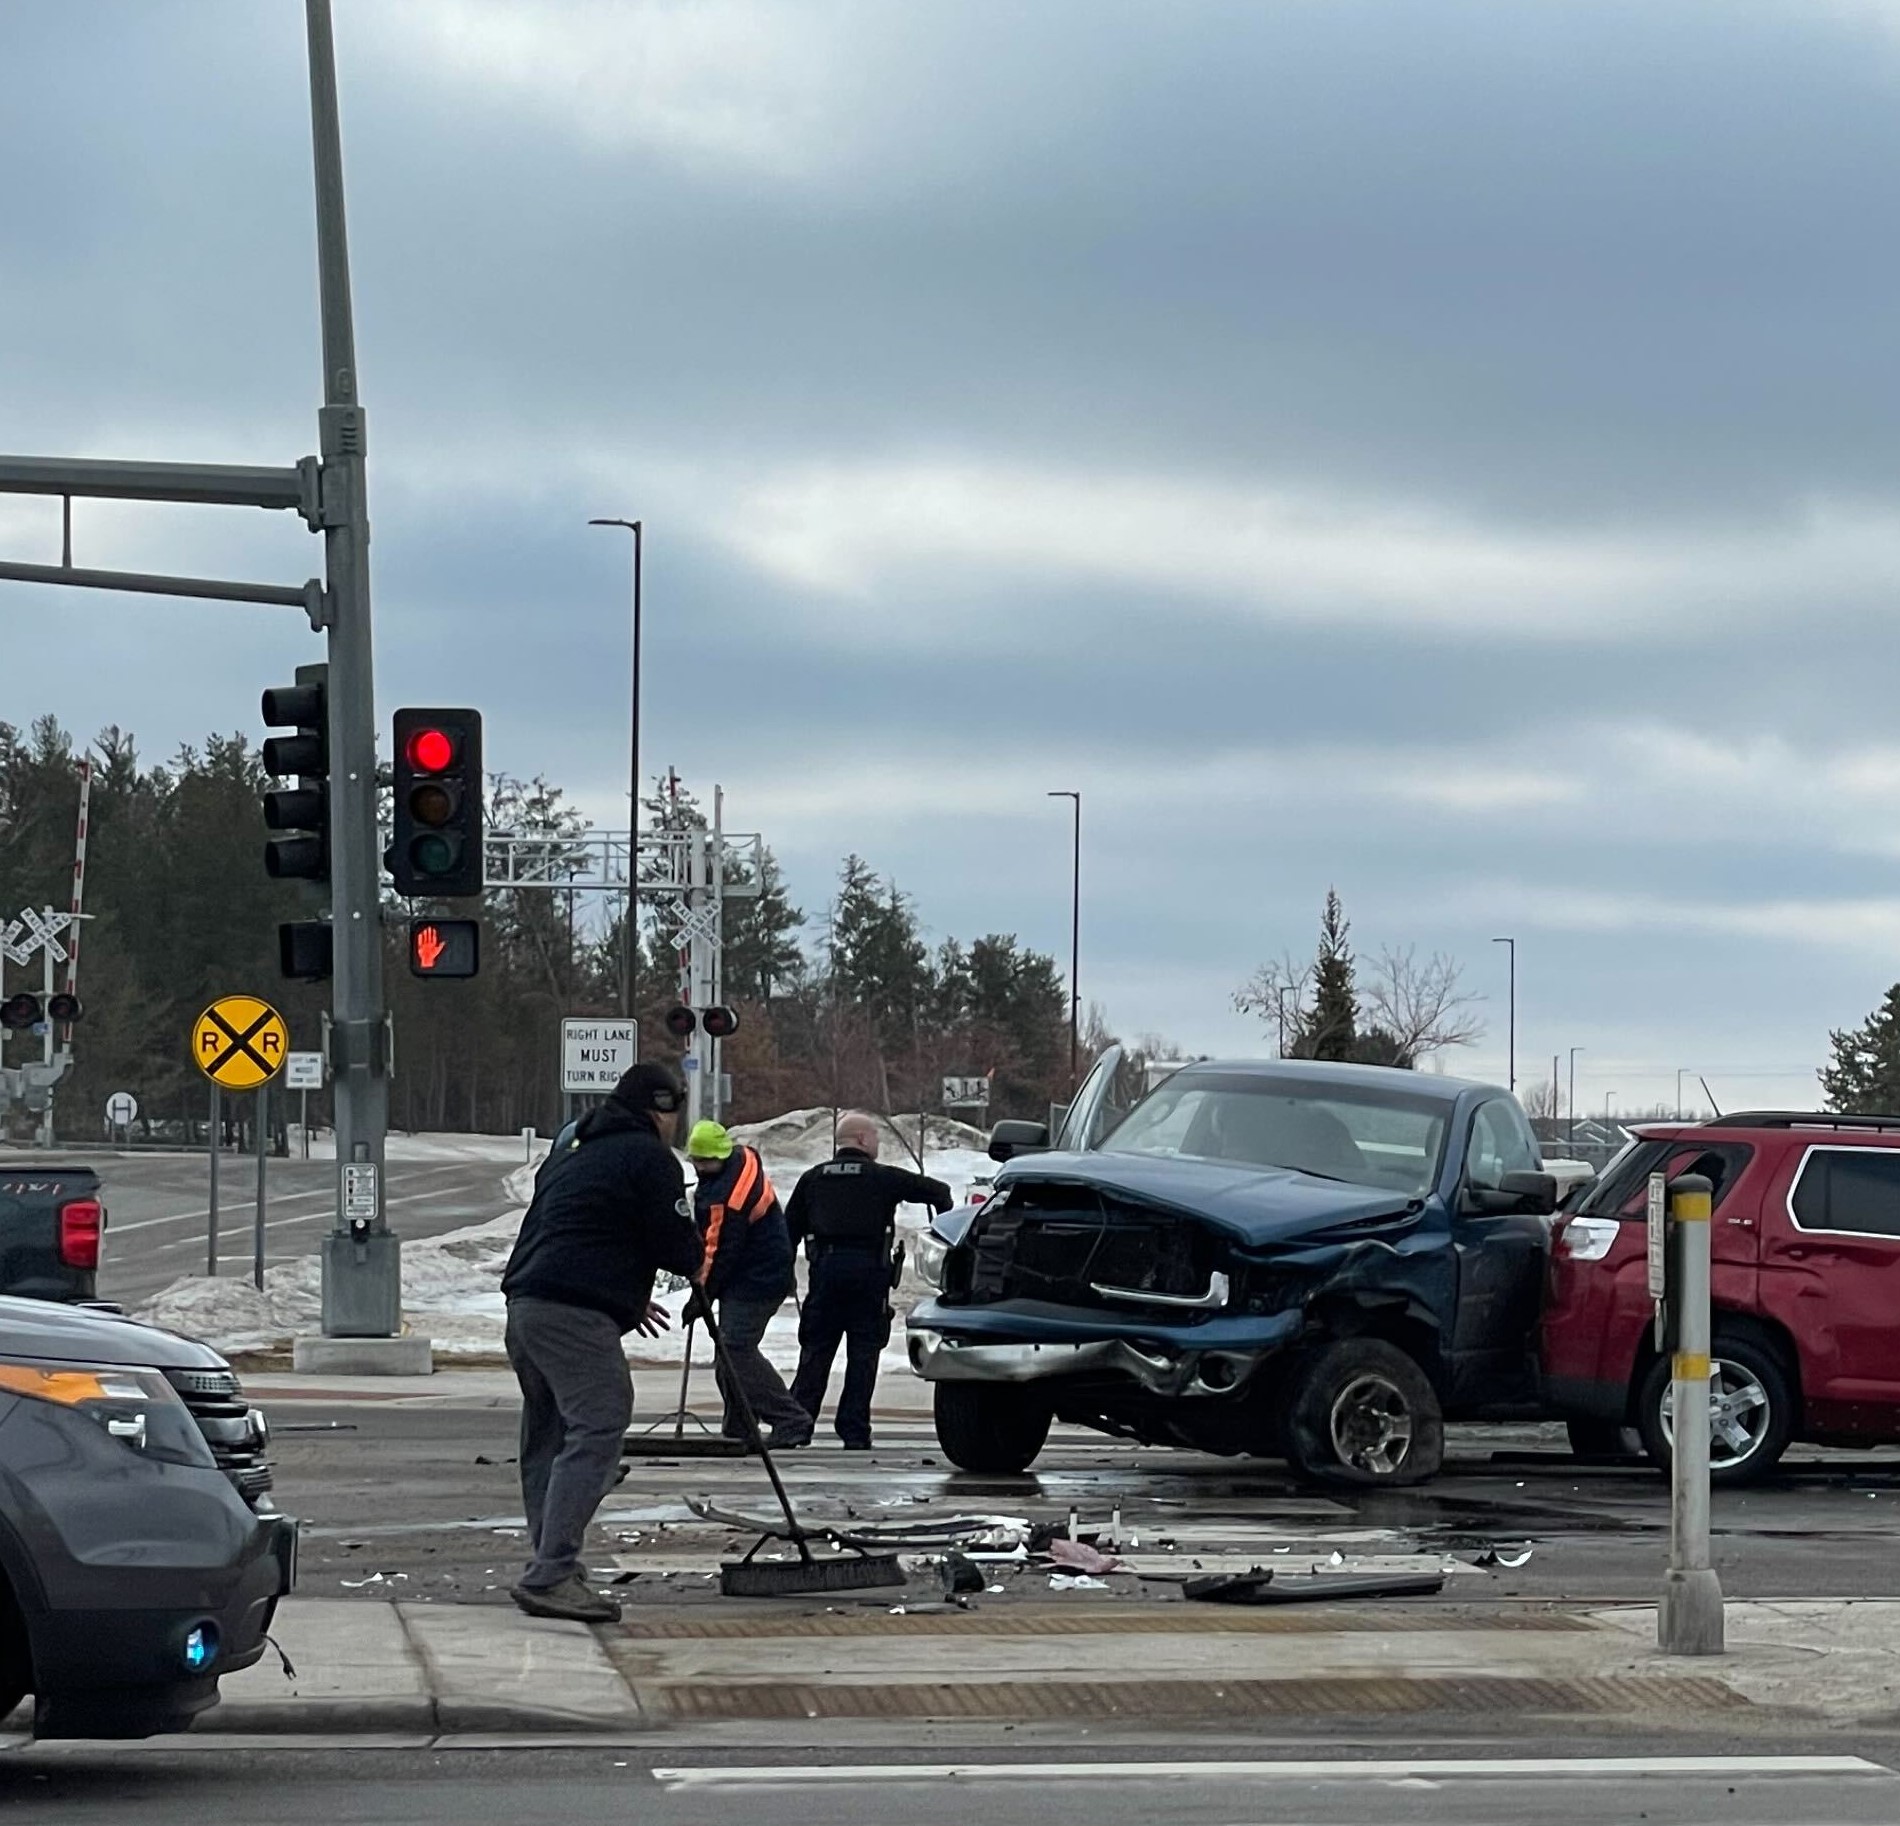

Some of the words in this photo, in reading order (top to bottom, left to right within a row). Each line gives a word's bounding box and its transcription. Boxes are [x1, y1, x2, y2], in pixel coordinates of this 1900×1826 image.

[566, 1029, 598, 1040] RIGHT
[604, 1029, 632, 1041] LANE
[581, 1049, 617, 1062] MUST
[566, 1070, 595, 1082] TURN
[600, 1071, 621, 1082] RIG
